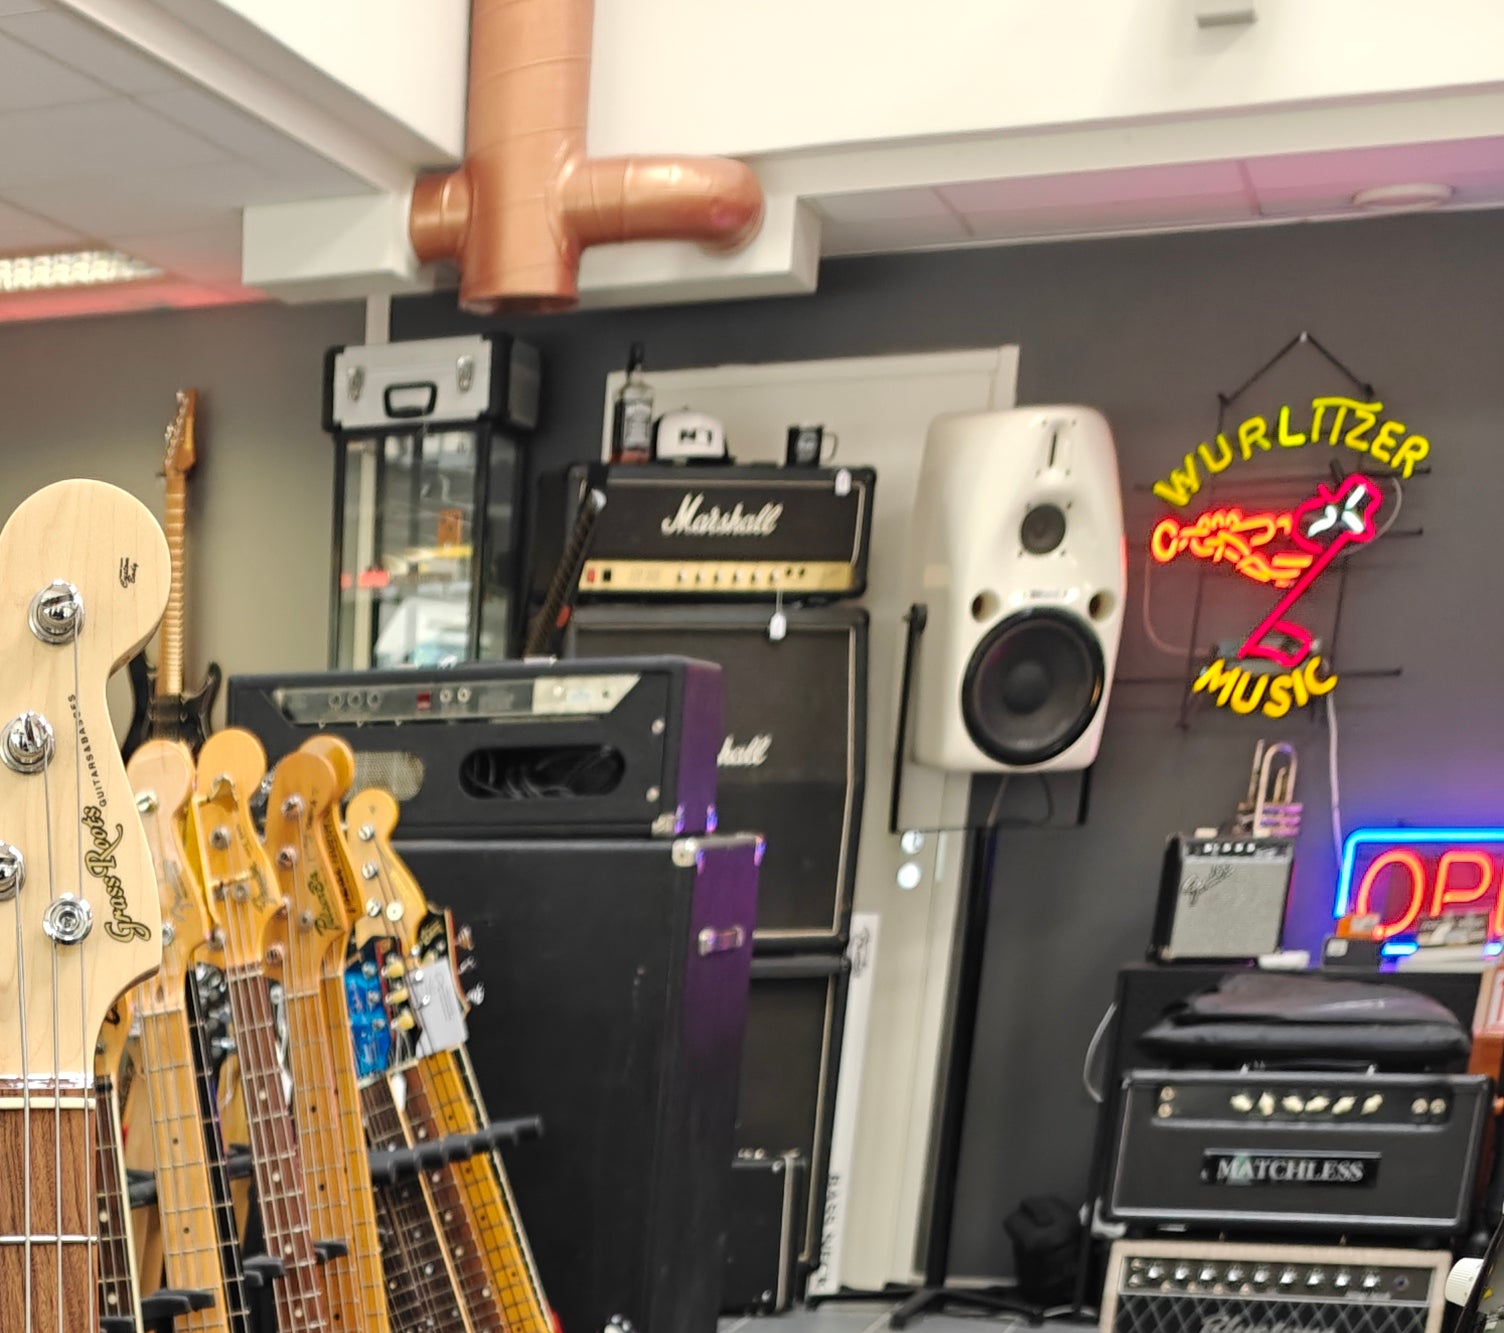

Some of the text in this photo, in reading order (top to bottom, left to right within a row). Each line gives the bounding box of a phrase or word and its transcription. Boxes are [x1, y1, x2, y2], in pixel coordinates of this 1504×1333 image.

[1152, 396, 1430, 507] WURLITZER
[660, 491, 784, 537] Marshall
[1193, 655, 1338, 719] MUSIC
[717, 734, 773, 767] hall
[1216, 1158, 1364, 1182] MATCHLESS
